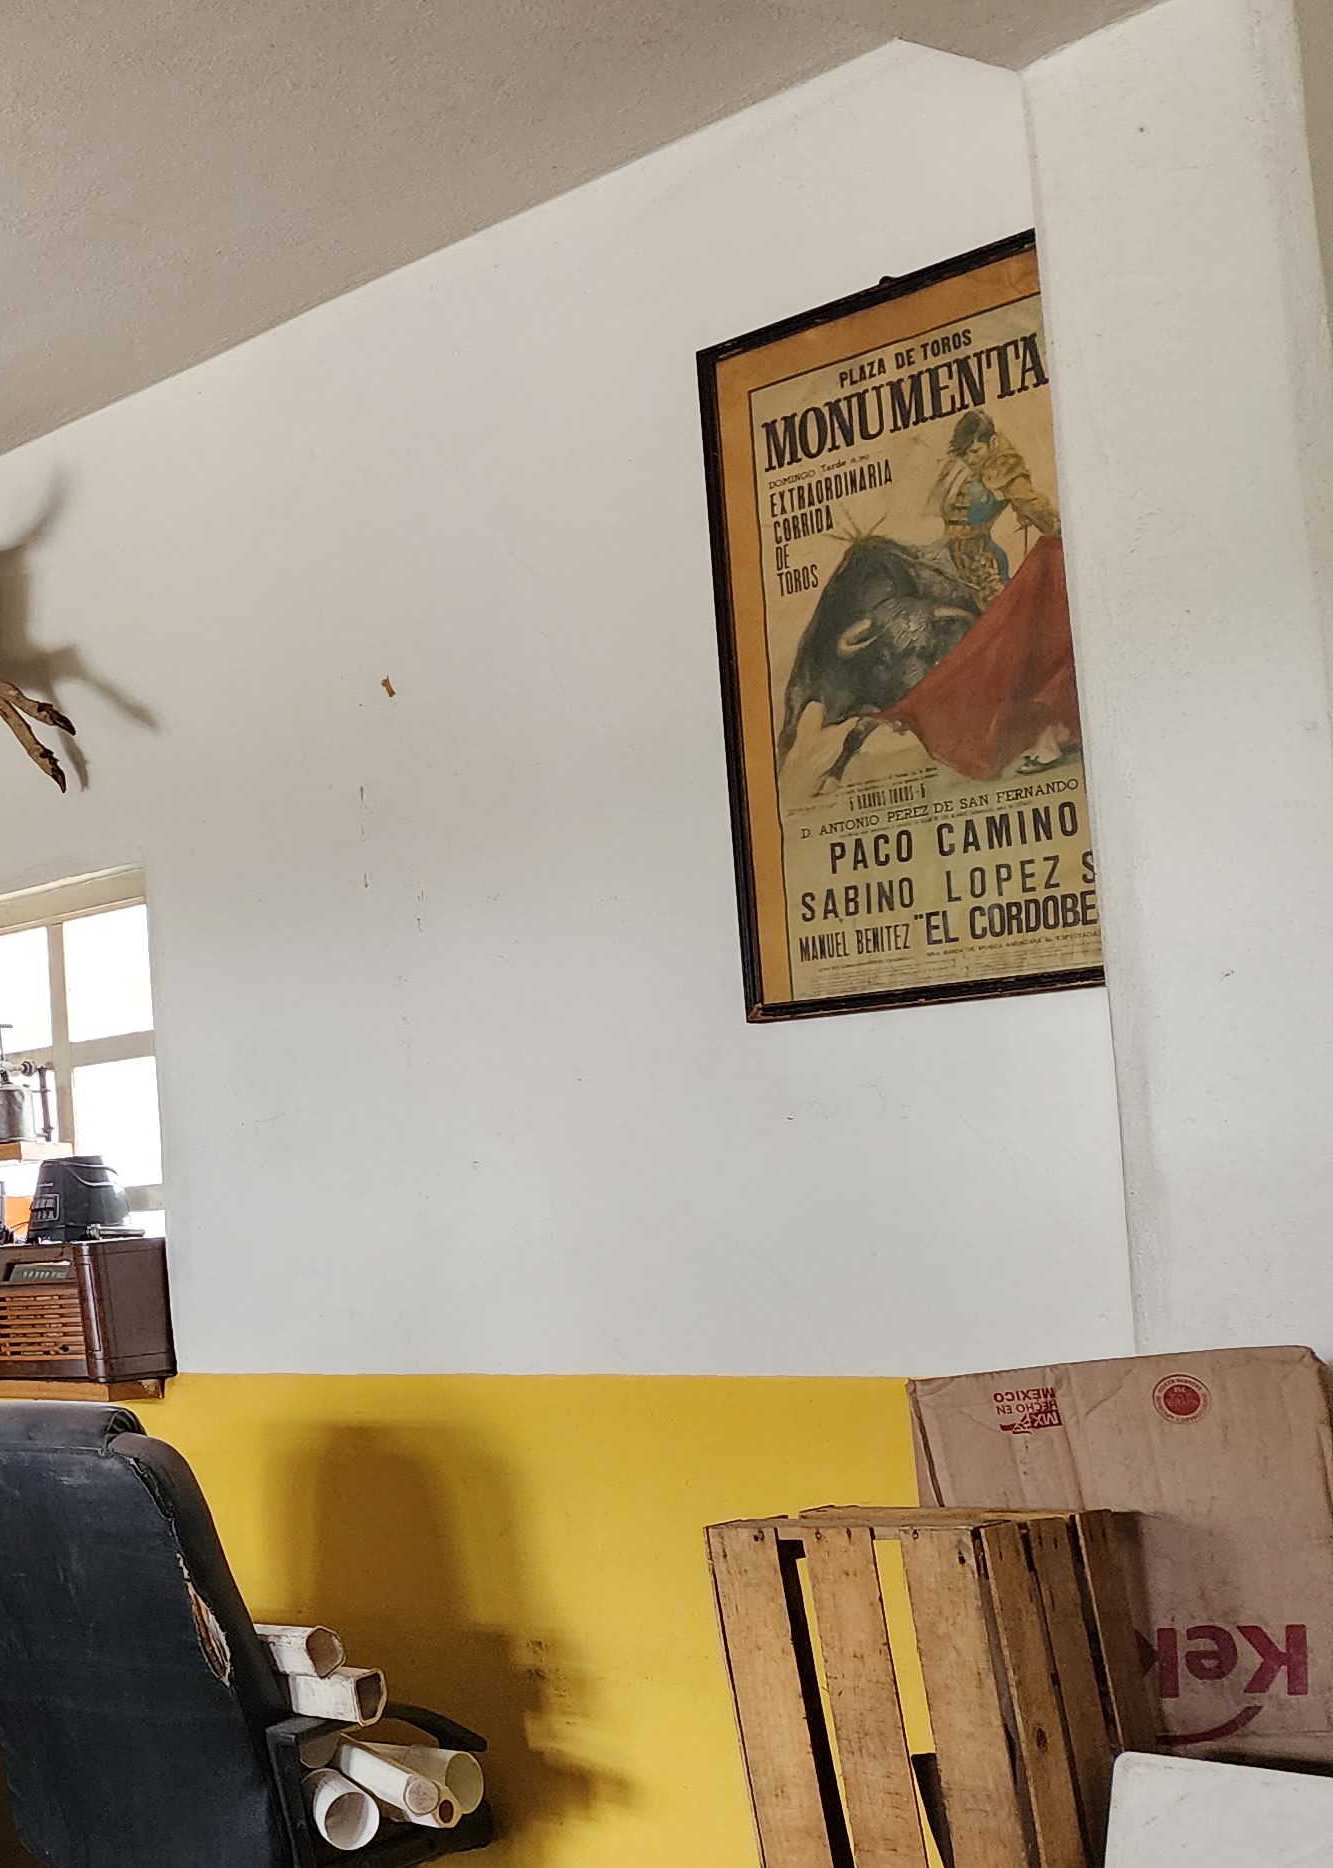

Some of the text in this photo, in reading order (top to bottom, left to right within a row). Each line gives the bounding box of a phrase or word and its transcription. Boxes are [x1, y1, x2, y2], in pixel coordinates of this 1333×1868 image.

[839, 329, 972, 388] PLAZA DE TOROS
[761, 332, 1049, 472] MONUMENTA
[768, 470, 816, 489] DOMINGO
[821, 460, 846, 473] Tarde
[770, 459, 893, 518] EXTRAORDINARIA
[773, 505, 834, 545] CORRIDA
[776, 544, 790, 571] DE
[777, 564, 819, 597] TOROS
[819, 815, 880, 836] ANTONIO
[888, 805, 929, 822] PEREZ
[933, 800, 954, 813] DE
[960, 794, 989, 809] SAN
[996, 778, 1079, 803] FERNANDO
[830, 801, 1078, 874] PACO CAMINO
[801, 877, 914, 922] SABINO
[945, 855, 1060, 902] LOPEZ
[799, 928, 849, 962] MANUEL
[855, 923, 911, 956] BENITEZ
[969, 889, 1098, 940] CORDOBE
[996, 1400, 1058, 1415] HECHO EN
